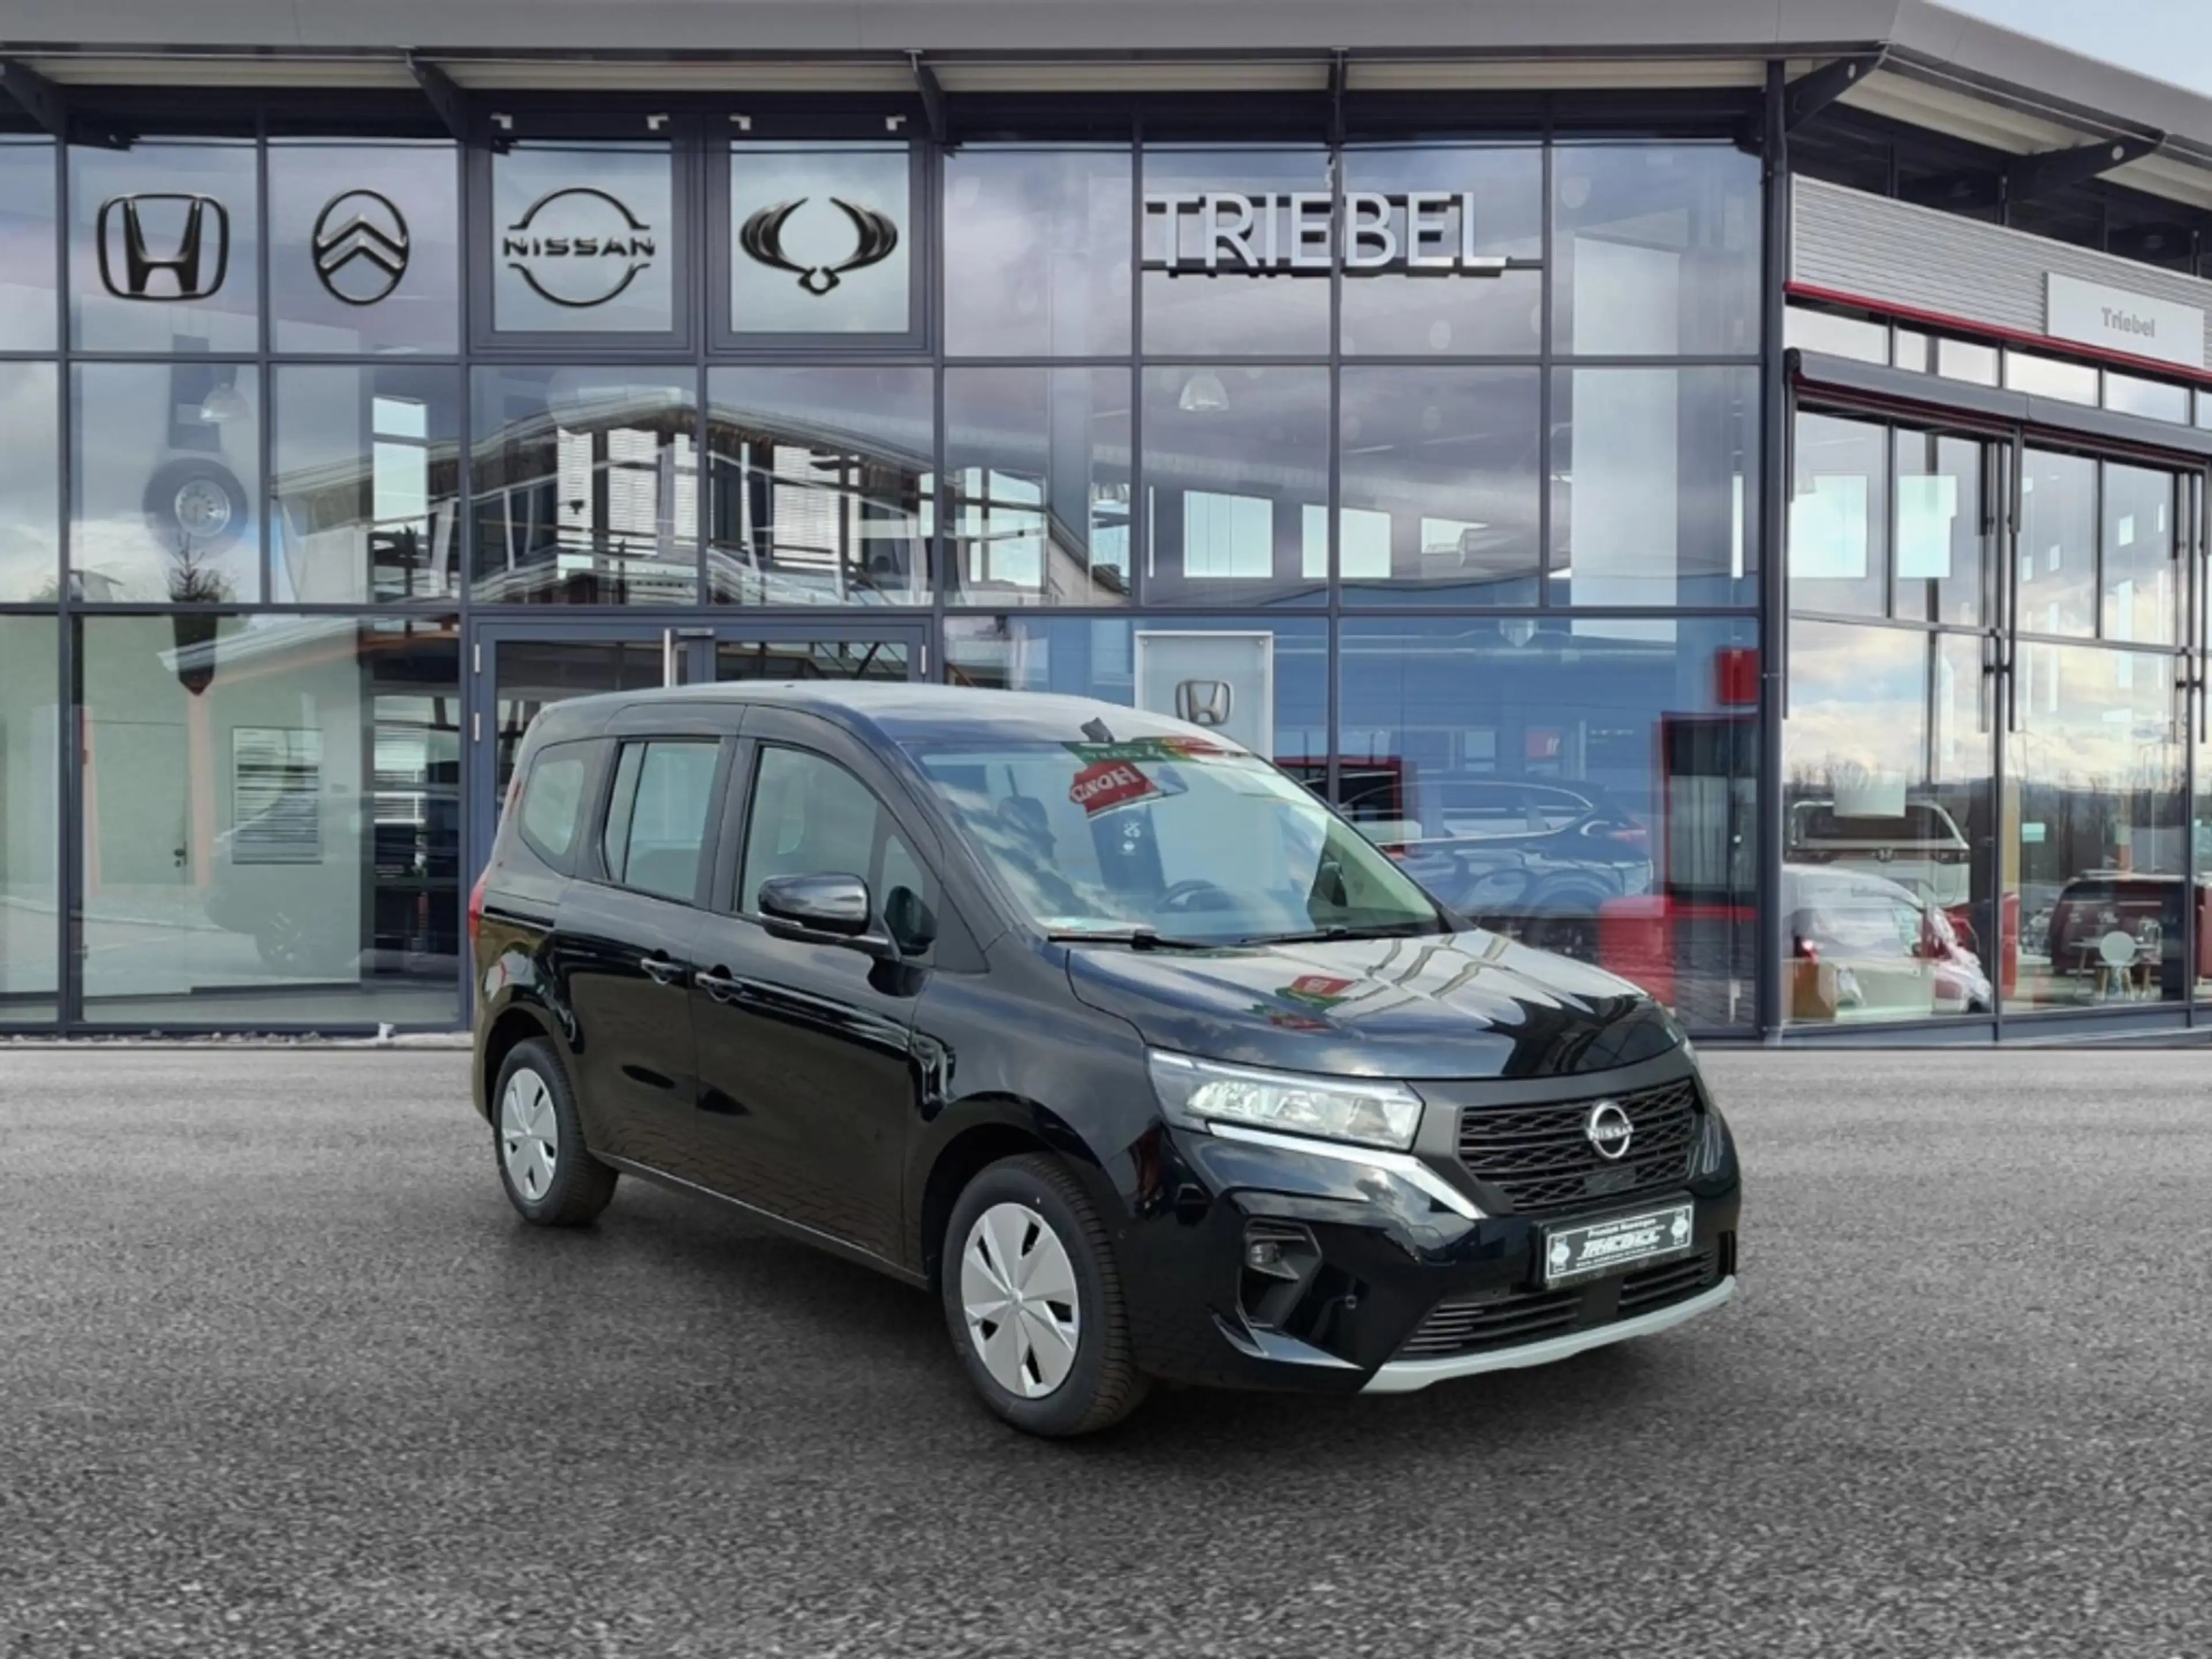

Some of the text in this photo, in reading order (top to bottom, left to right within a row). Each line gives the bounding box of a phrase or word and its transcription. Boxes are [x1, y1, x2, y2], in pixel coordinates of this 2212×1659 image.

[1145, 192, 1506, 267] TRIEBEL
[503, 236, 656, 257] NISSAN
[2100, 306, 2155, 338] Triebel
